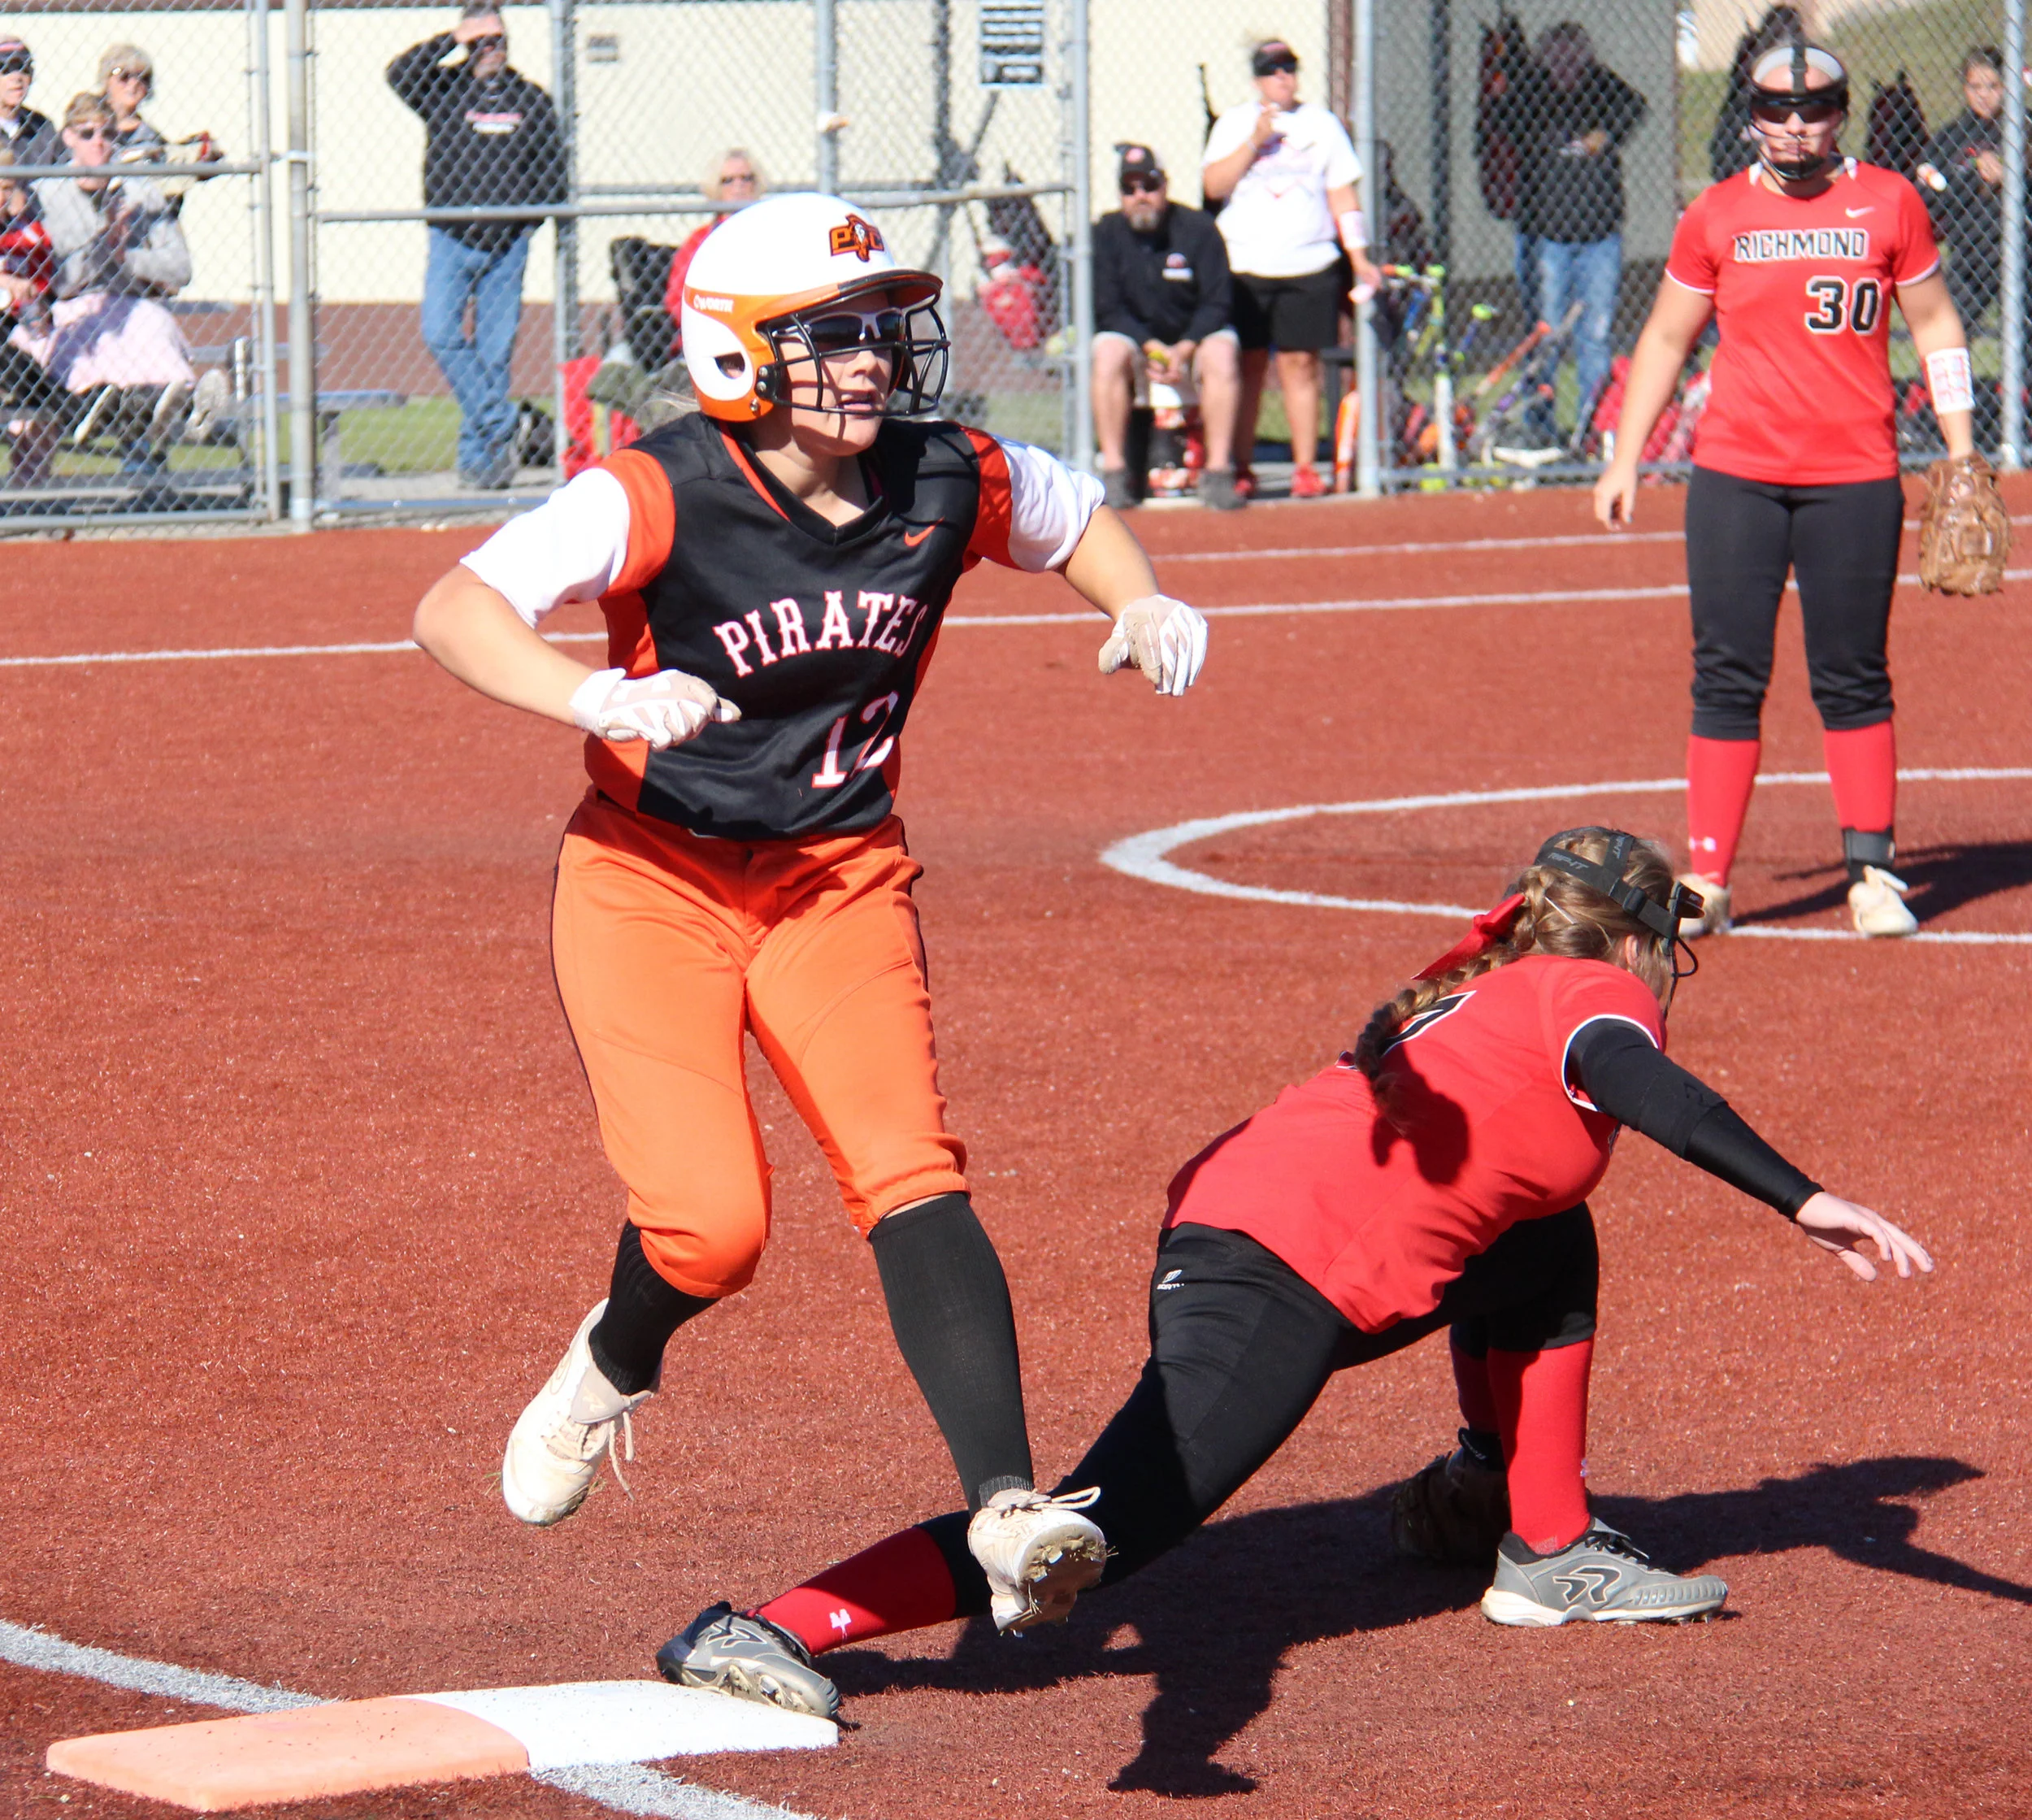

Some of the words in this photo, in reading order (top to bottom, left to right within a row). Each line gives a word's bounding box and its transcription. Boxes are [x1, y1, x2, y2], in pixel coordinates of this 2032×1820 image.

[1733, 227, 1869, 263] RICHMOND
[1804, 275, 1882, 335] 30
[712, 590, 928, 678] PIRATES
[811, 690, 900, 788] 12
[1547, 852, 1590, 870] RIP-IT
